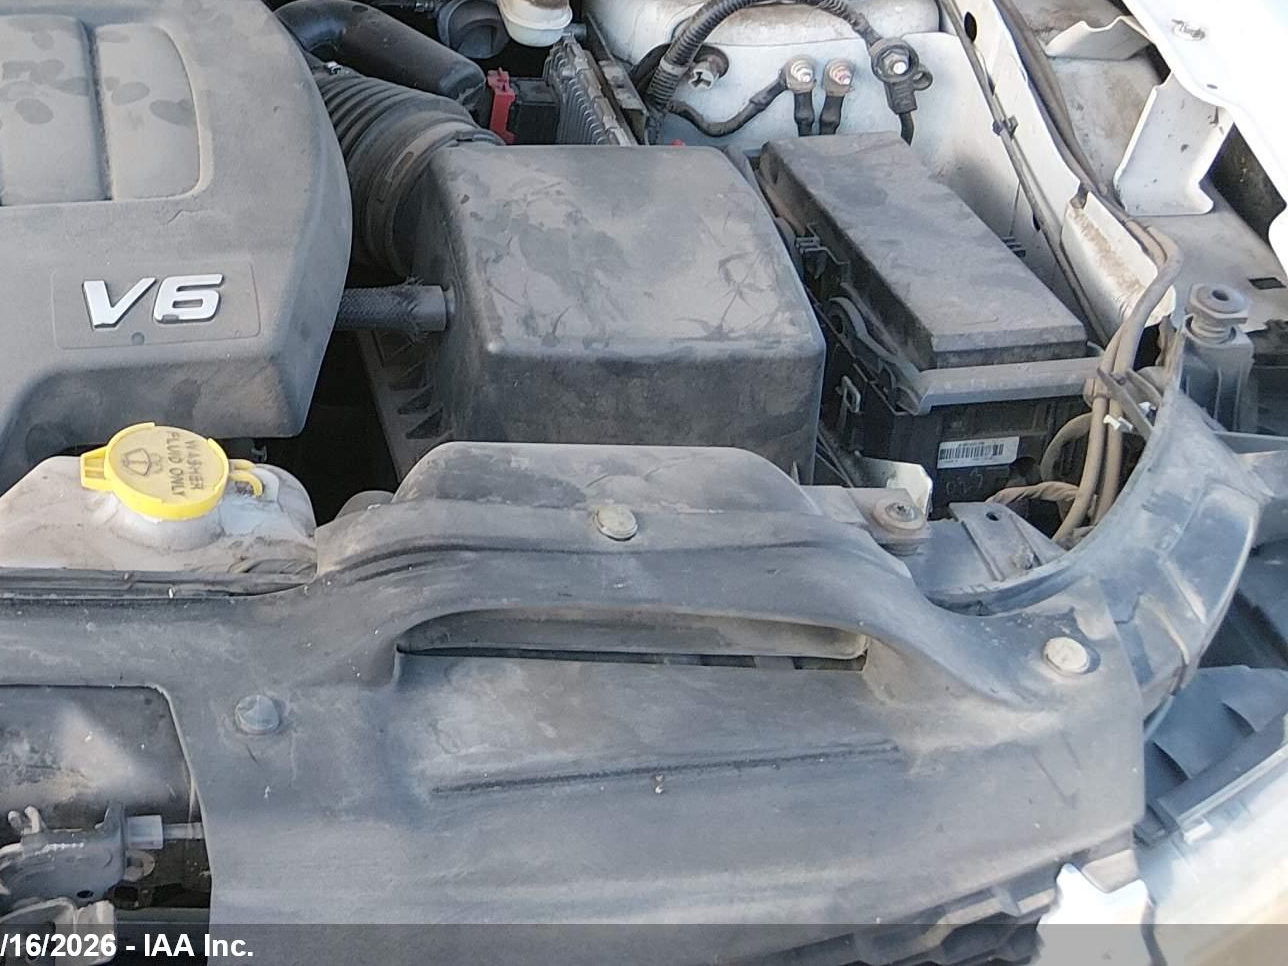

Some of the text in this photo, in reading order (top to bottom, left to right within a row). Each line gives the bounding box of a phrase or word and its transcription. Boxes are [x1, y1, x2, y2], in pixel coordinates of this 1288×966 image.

[82, 273, 225, 330] V6
[166, 431, 186, 498] FLUID ONLY
[184, 440, 205, 491] WASHER
